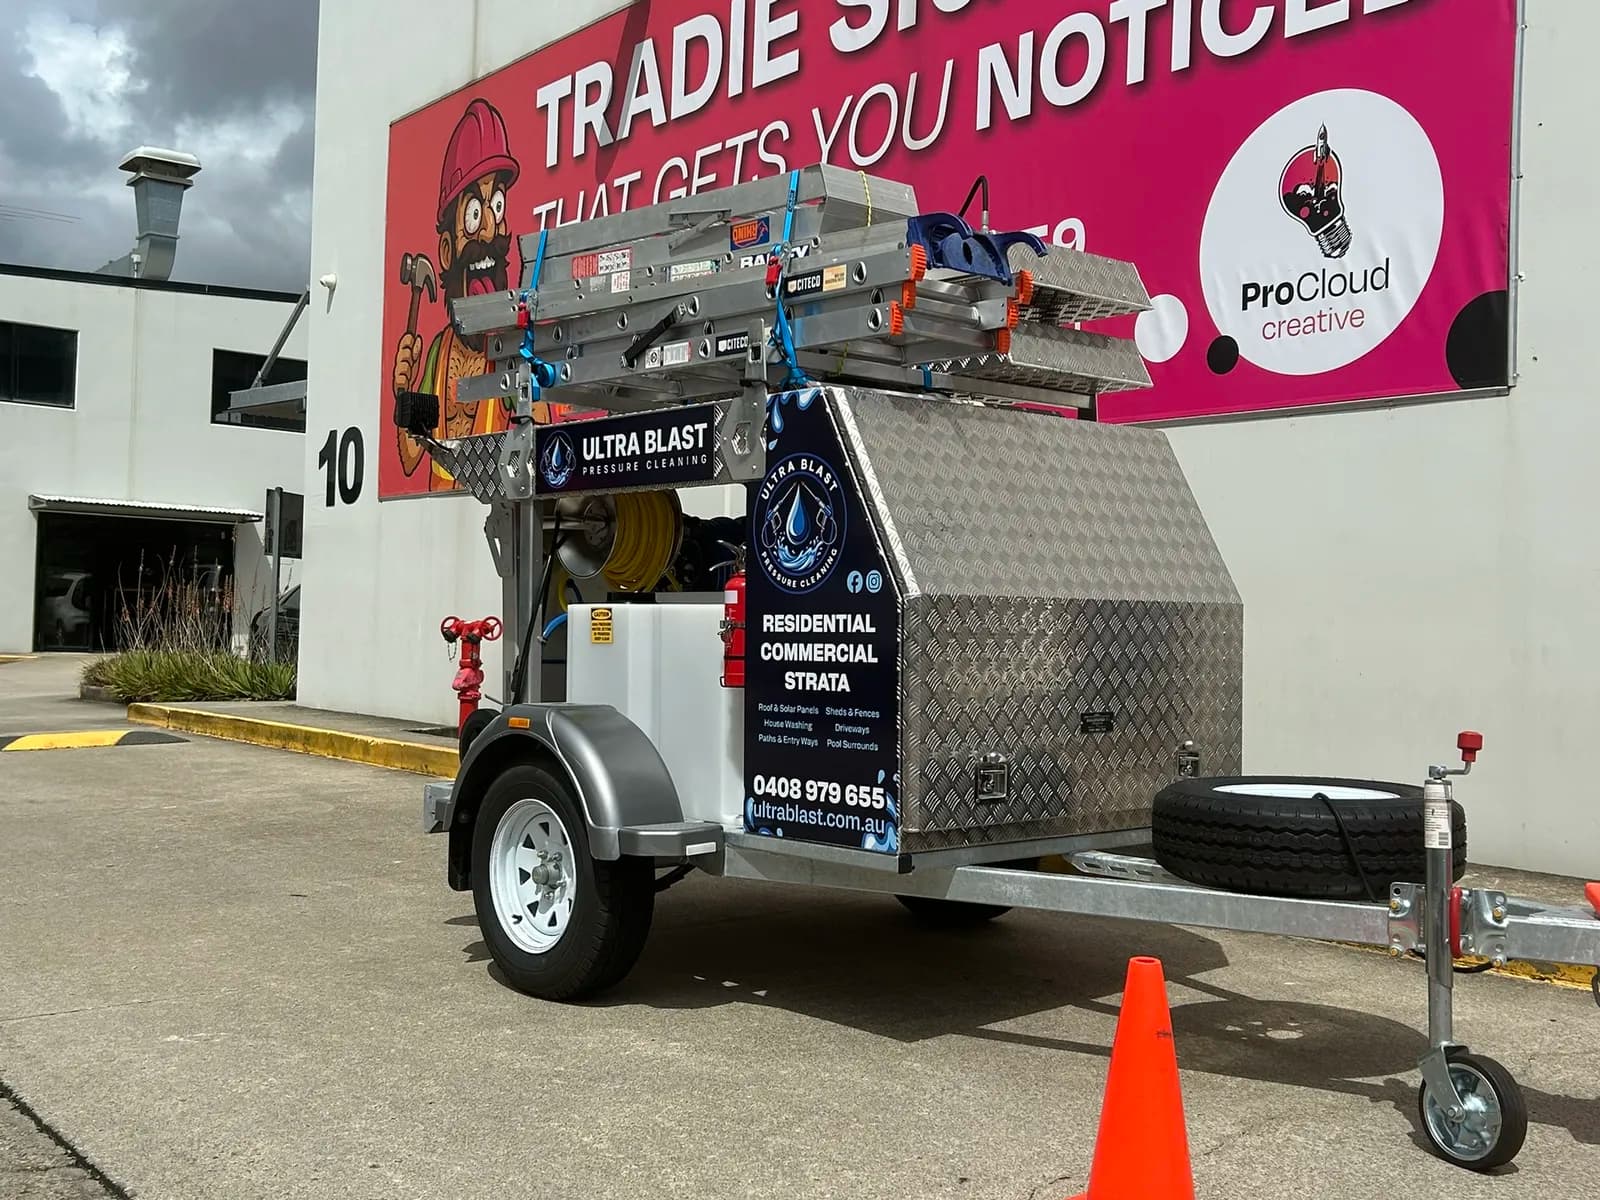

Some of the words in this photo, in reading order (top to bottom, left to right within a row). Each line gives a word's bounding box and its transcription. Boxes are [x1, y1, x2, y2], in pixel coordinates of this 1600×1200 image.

[535, 0, 799, 168] TRADIE
[652, 120, 790, 203] GETS
[811, 59, 954, 166] YOU
[797, 275, 821, 291] CITECO
[1241, 257, 1390, 311] ProCloud
[1262, 307, 1365, 340] creative
[582, 432, 641, 461] ULTRA
[644, 423, 708, 455] BLAST
[318, 426, 365, 508] 10
[582, 460, 639, 476] PRESSURE
[646, 454, 708, 471] CLEANING
[761, 460, 795, 500] ULTRA
[801, 458, 838, 492] BLAST
[761, 551, 797, 588] PRESSURE
[800, 548, 838, 588] CLEANING
[763, 614, 876, 633] RESIDENTIAL
[760, 642, 879, 663] COMMERCIAL
[785, 671, 850, 692] STRATA
[758, 703, 773, 712] Roof
[773, 704, 779, 712] &
[779, 704, 796, 713] Solar
[797, 705, 819, 715] Panels
[825, 706, 847, 716] Sheds
[847, 708, 854, 717] &
[854, 709, 880, 718] Fences
[764, 719, 784, 728] House
[785, 720, 813, 732] Washing
[835, 723, 870, 735] Driveways
[758, 734, 776, 743] Paths
[777, 735, 782, 744] &
[783, 736, 800, 746] Entry
[800, 737, 819, 747] Ways
[827, 739, 842, 748] Pool
[842, 740, 879, 751] Surrounds
[753, 775, 801, 798] 0408
[805, 780, 842, 804] 979
[844, 784, 885, 809] 655
[753, 800, 885, 834] ultrablast.com.au
